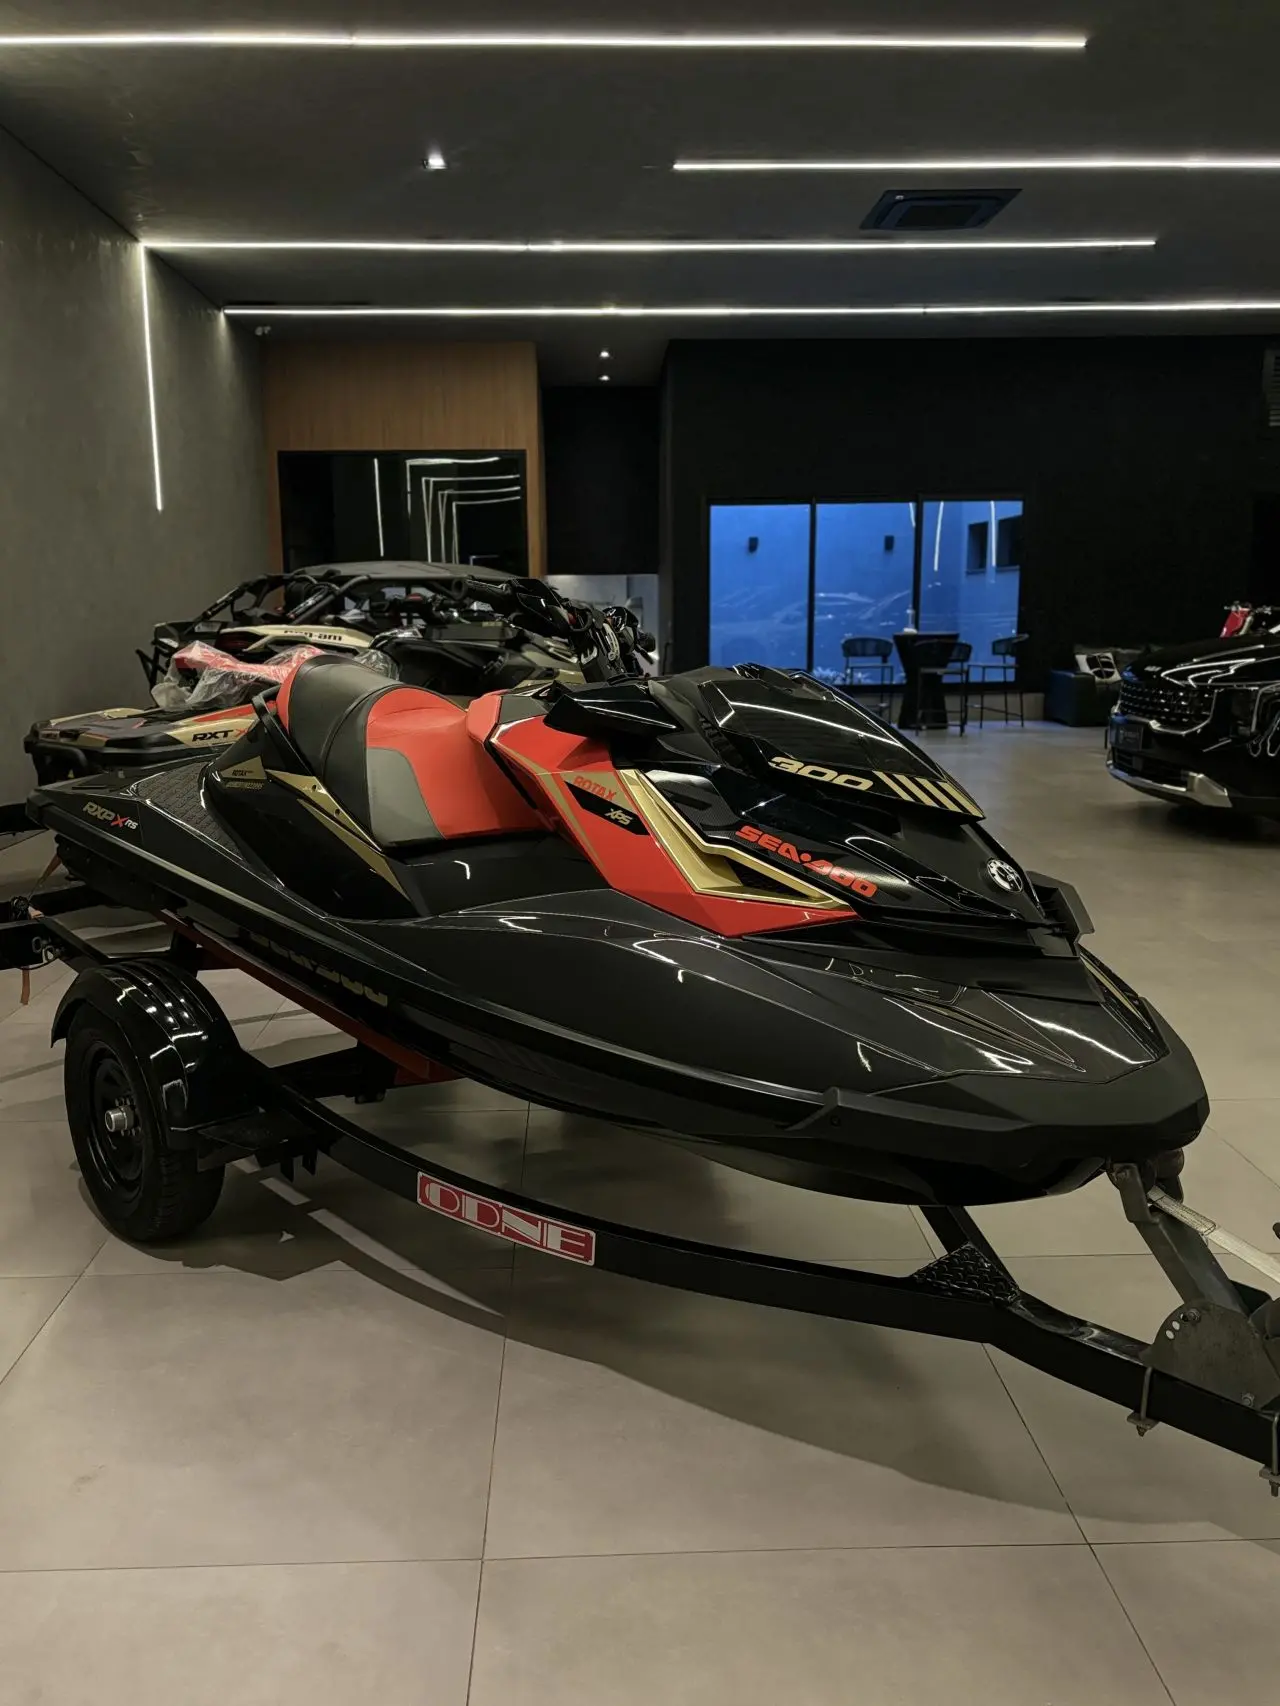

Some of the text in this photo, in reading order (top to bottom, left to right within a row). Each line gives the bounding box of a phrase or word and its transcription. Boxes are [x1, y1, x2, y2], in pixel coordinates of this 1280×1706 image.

[284, 629, 343, 642] n-am
[192, 729, 234, 742] RXT
[767, 756, 874, 792] 300
[573, 775, 617, 801] ROTAX
[604, 808, 633, 826] XPS
[424, 1182, 586, 1259] ODNE
